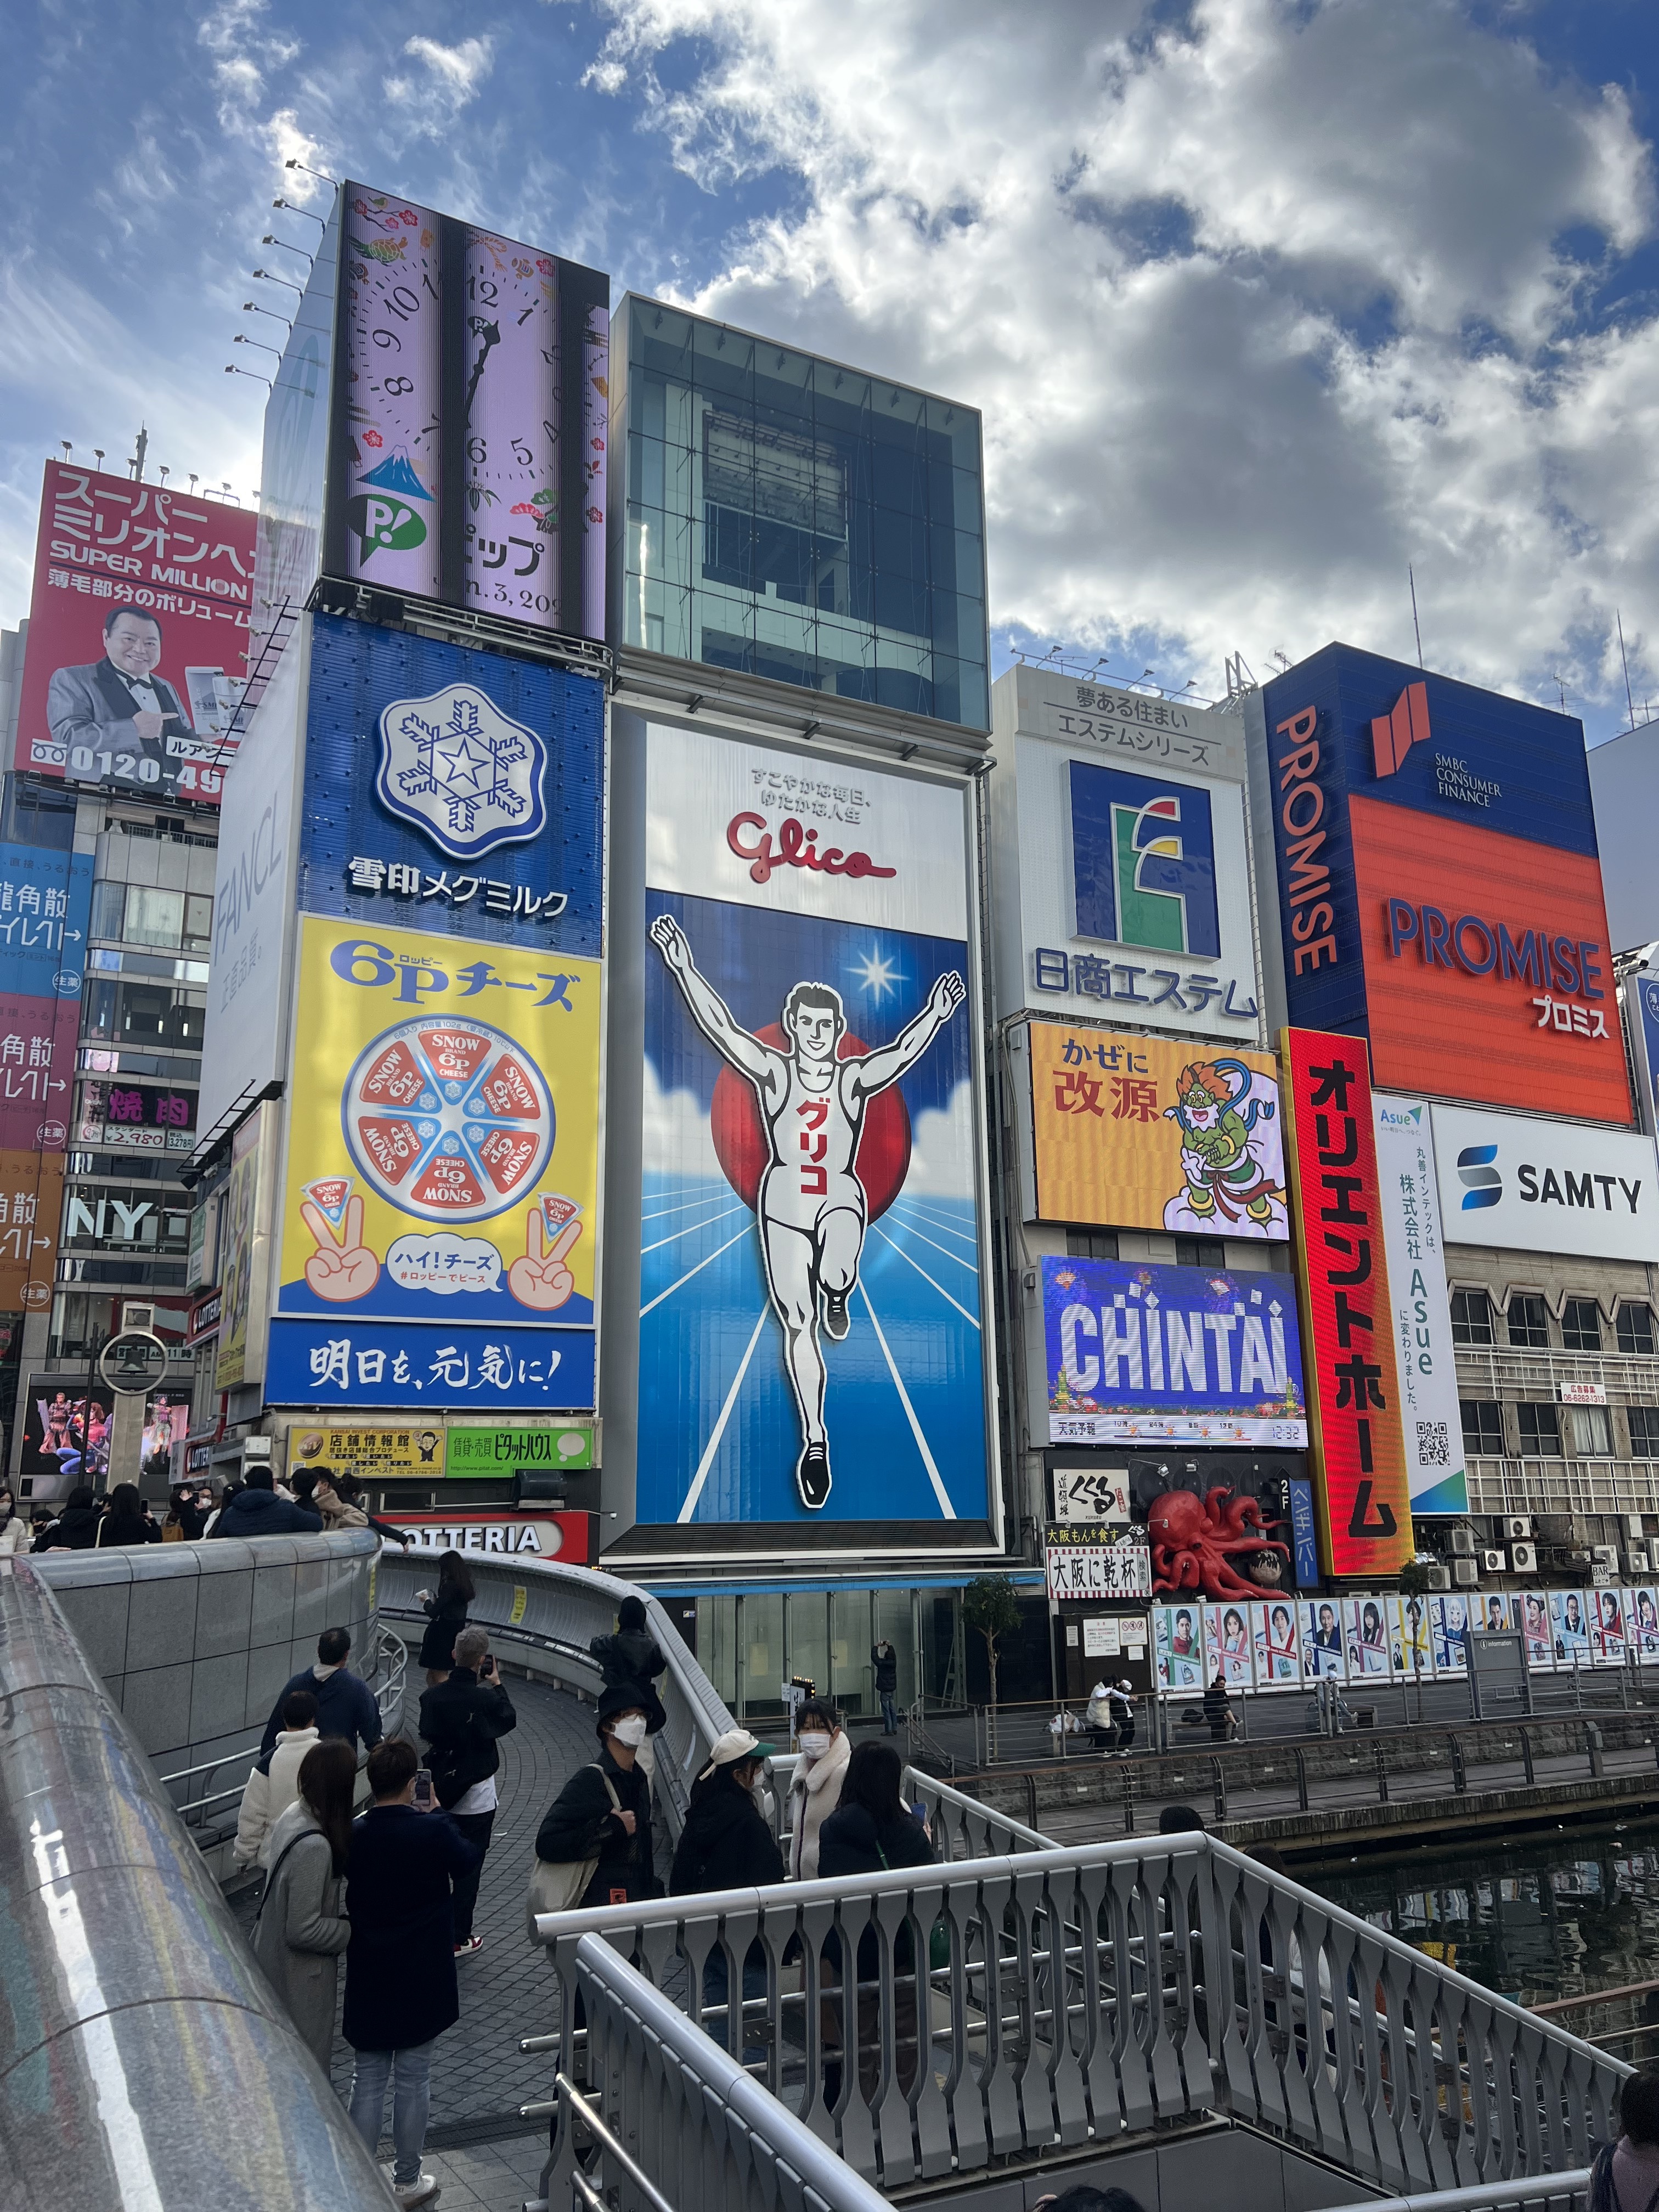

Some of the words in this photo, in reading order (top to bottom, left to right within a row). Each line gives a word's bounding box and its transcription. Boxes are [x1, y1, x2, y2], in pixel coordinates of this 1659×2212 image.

[383, 286, 420, 321] 10
[466, 276, 499, 308] 12
[517, 308, 534, 326] 1
[373, 329, 401, 352] 9
[384, 376, 414, 396] 8
[467, 437, 487, 463] 6
[511, 438, 533, 465] 5
[56, 470, 208, 524] スーパー
[53, 503, 257, 579] ミリオンヘ
[49, 540, 143, 576] SUPER
[151, 563, 247, 601] MILLION
[1076, 686, 1188, 730] 夢ある住まい
[1058, 714, 1209, 766] エステムシリーズ
[1435, 753, 1468, 774] SMBC
[751, 768, 872, 808] すこやかな毎日、
[1436, 767, 1503, 798] CONSUMER
[1438, 781, 1491, 808] FINANCE
[760, 790, 861, 825] ゆたかな人生
[1276, 706, 1337, 977] PROMISE
[214, 806, 281, 967] FANCL
[348, 855, 568, 917] 雪印メグミルク
[399, 952, 443, 966] ロッピー
[1387, 898, 1605, 1000] PROMISE
[1034, 947, 1259, 1019] 日商エステム
[1531, 994, 1610, 1040] プロミス
[432, 1034, 481, 1052] SNOW
[1062, 1039, 1148, 1074] かぜに
[368, 1049, 402, 1094] SNOW
[386, 1068, 400, 1087] BRAND
[439, 1069, 469, 1079] CHEESE
[403, 1079, 424, 1104] CHEESE
[483, 1086, 502, 1114] CHEESE
[505, 1065, 536, 1110] SNOW
[505, 1081, 518, 1102] BRAND
[1052, 1069, 1160, 1123] 改源
[1380, 1109, 1411, 1126] Asue
[363, 1127, 398, 1173] SNOW
[383, 1135, 396, 1156] BRAND
[401, 1122, 420, 1151] CHEESE
[480, 1131, 500, 1158] CHEESE
[436, 1158, 465, 1168] CHEESE
[501, 1140, 533, 1186] SNOW
[316, 1183, 342, 1194] SNOW
[424, 1187, 473, 1203] SNOW
[1416, 1146, 1436, 1254] 丸善インテックは、
[1517, 1164, 1642, 1215] SAMTY
[66, 1198, 154, 1240] NY
[549, 1199, 572, 1212] SNOW
[1308, 1059, 1399, 1540] オリエントホーム
[1410, 1268, 1433, 1376] Asue
[1059, 1281, 1289, 1395] CHINTAI
[309, 1338, 562, 1391] 明日を、元気に!
[1399, 1310, 1418, 1412] に変わりました。
[1564, 1393, 1605, 1403] 06-6262-1313
[1571, 1385, 1596, 1394] 広告募集
[330, 1434, 410, 1447] 店舗情報館
[453, 1437, 492, 1458] 賃貸・売買
[495, 1433, 552, 1461] ピタットハウス
[1068, 1475, 1116, 1515] くくる
[402, 1525, 543, 1552] OTTERIA
[1047, 1527, 1120, 1544] 大阪もんを食す
[1133, 1536, 1147, 1546] 2F
[1293, 1488, 1314, 1577] ペンギンバー
[1053, 1555, 1136, 1590] 大阪に乾杯
[1593, 1566, 1609, 1576] BAR
